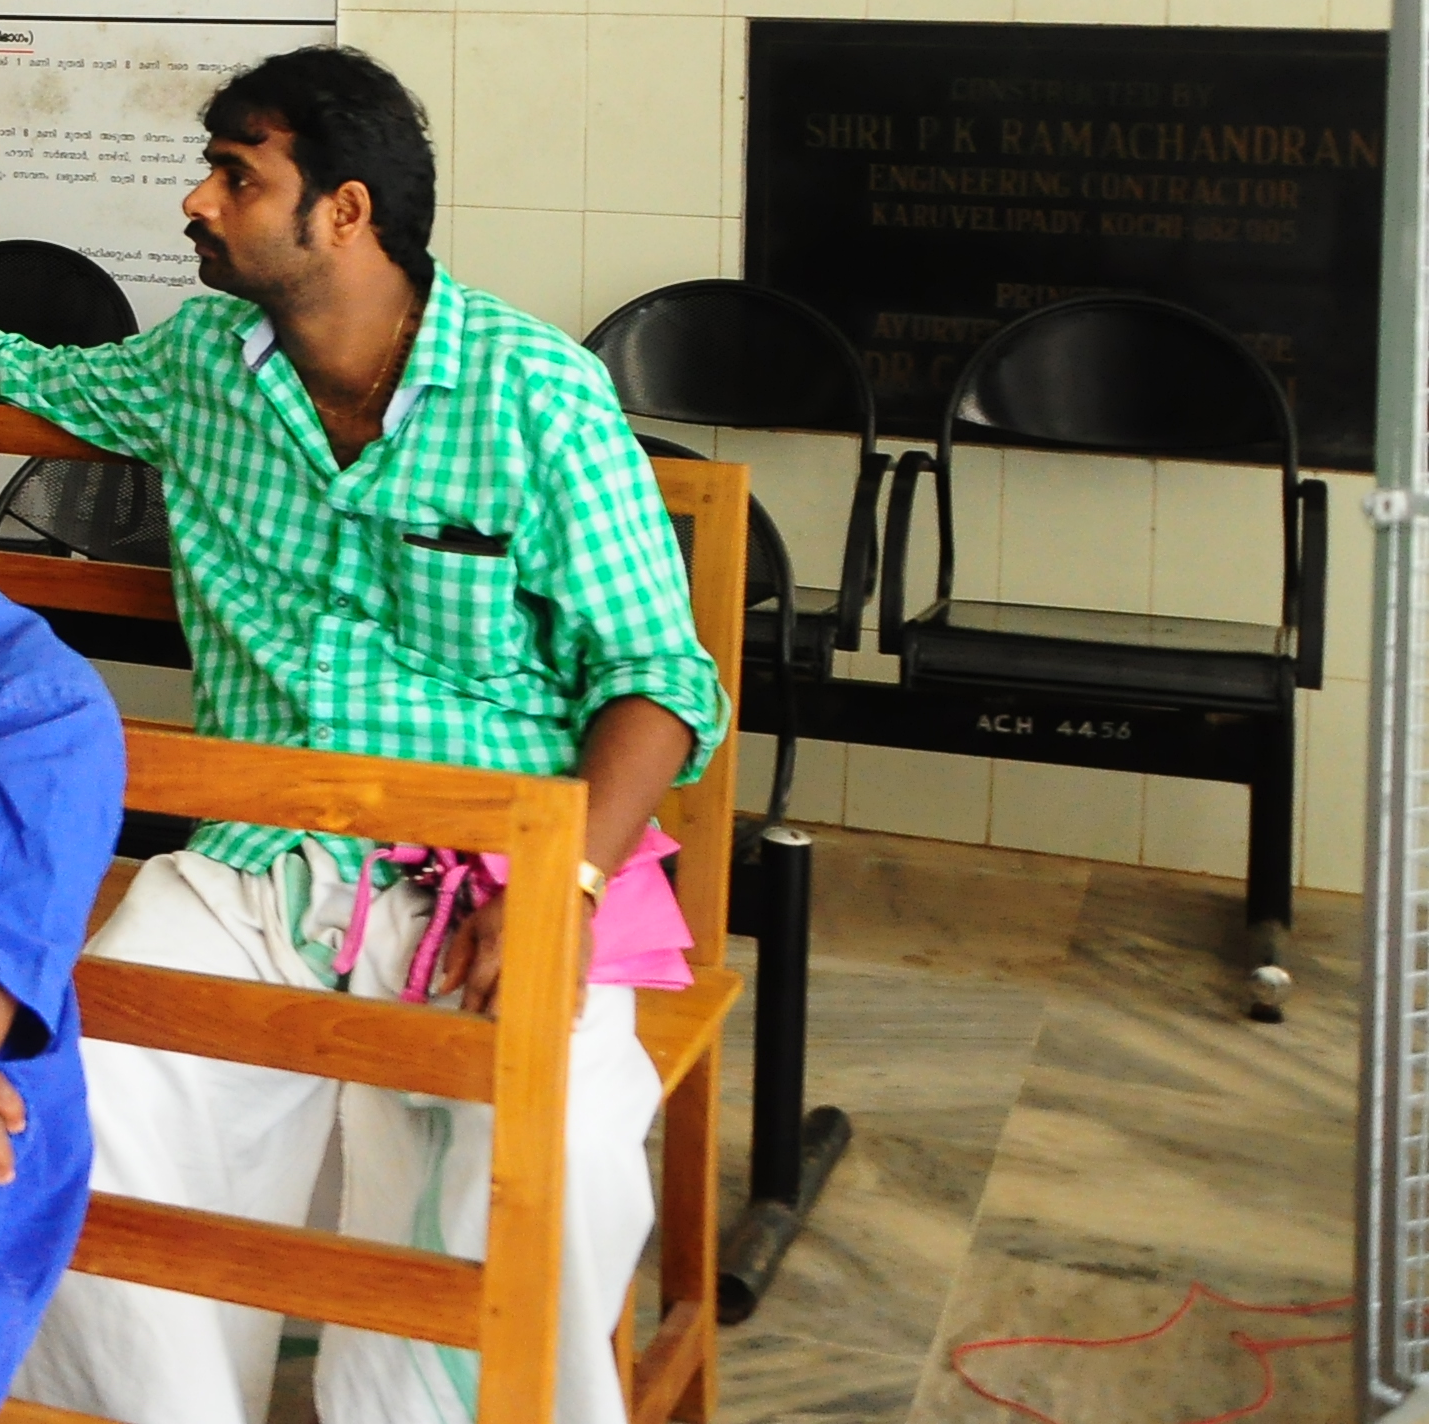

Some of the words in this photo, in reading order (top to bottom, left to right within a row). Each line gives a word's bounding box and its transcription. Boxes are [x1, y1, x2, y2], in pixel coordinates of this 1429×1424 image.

[805, 113, 894, 151] SHRI
[1000, 117, 1380, 170] RAMACHANDRAN
[868, 164, 1071, 199] ENGINEERING
[1081, 172, 1300, 210] CONTRACTOR
